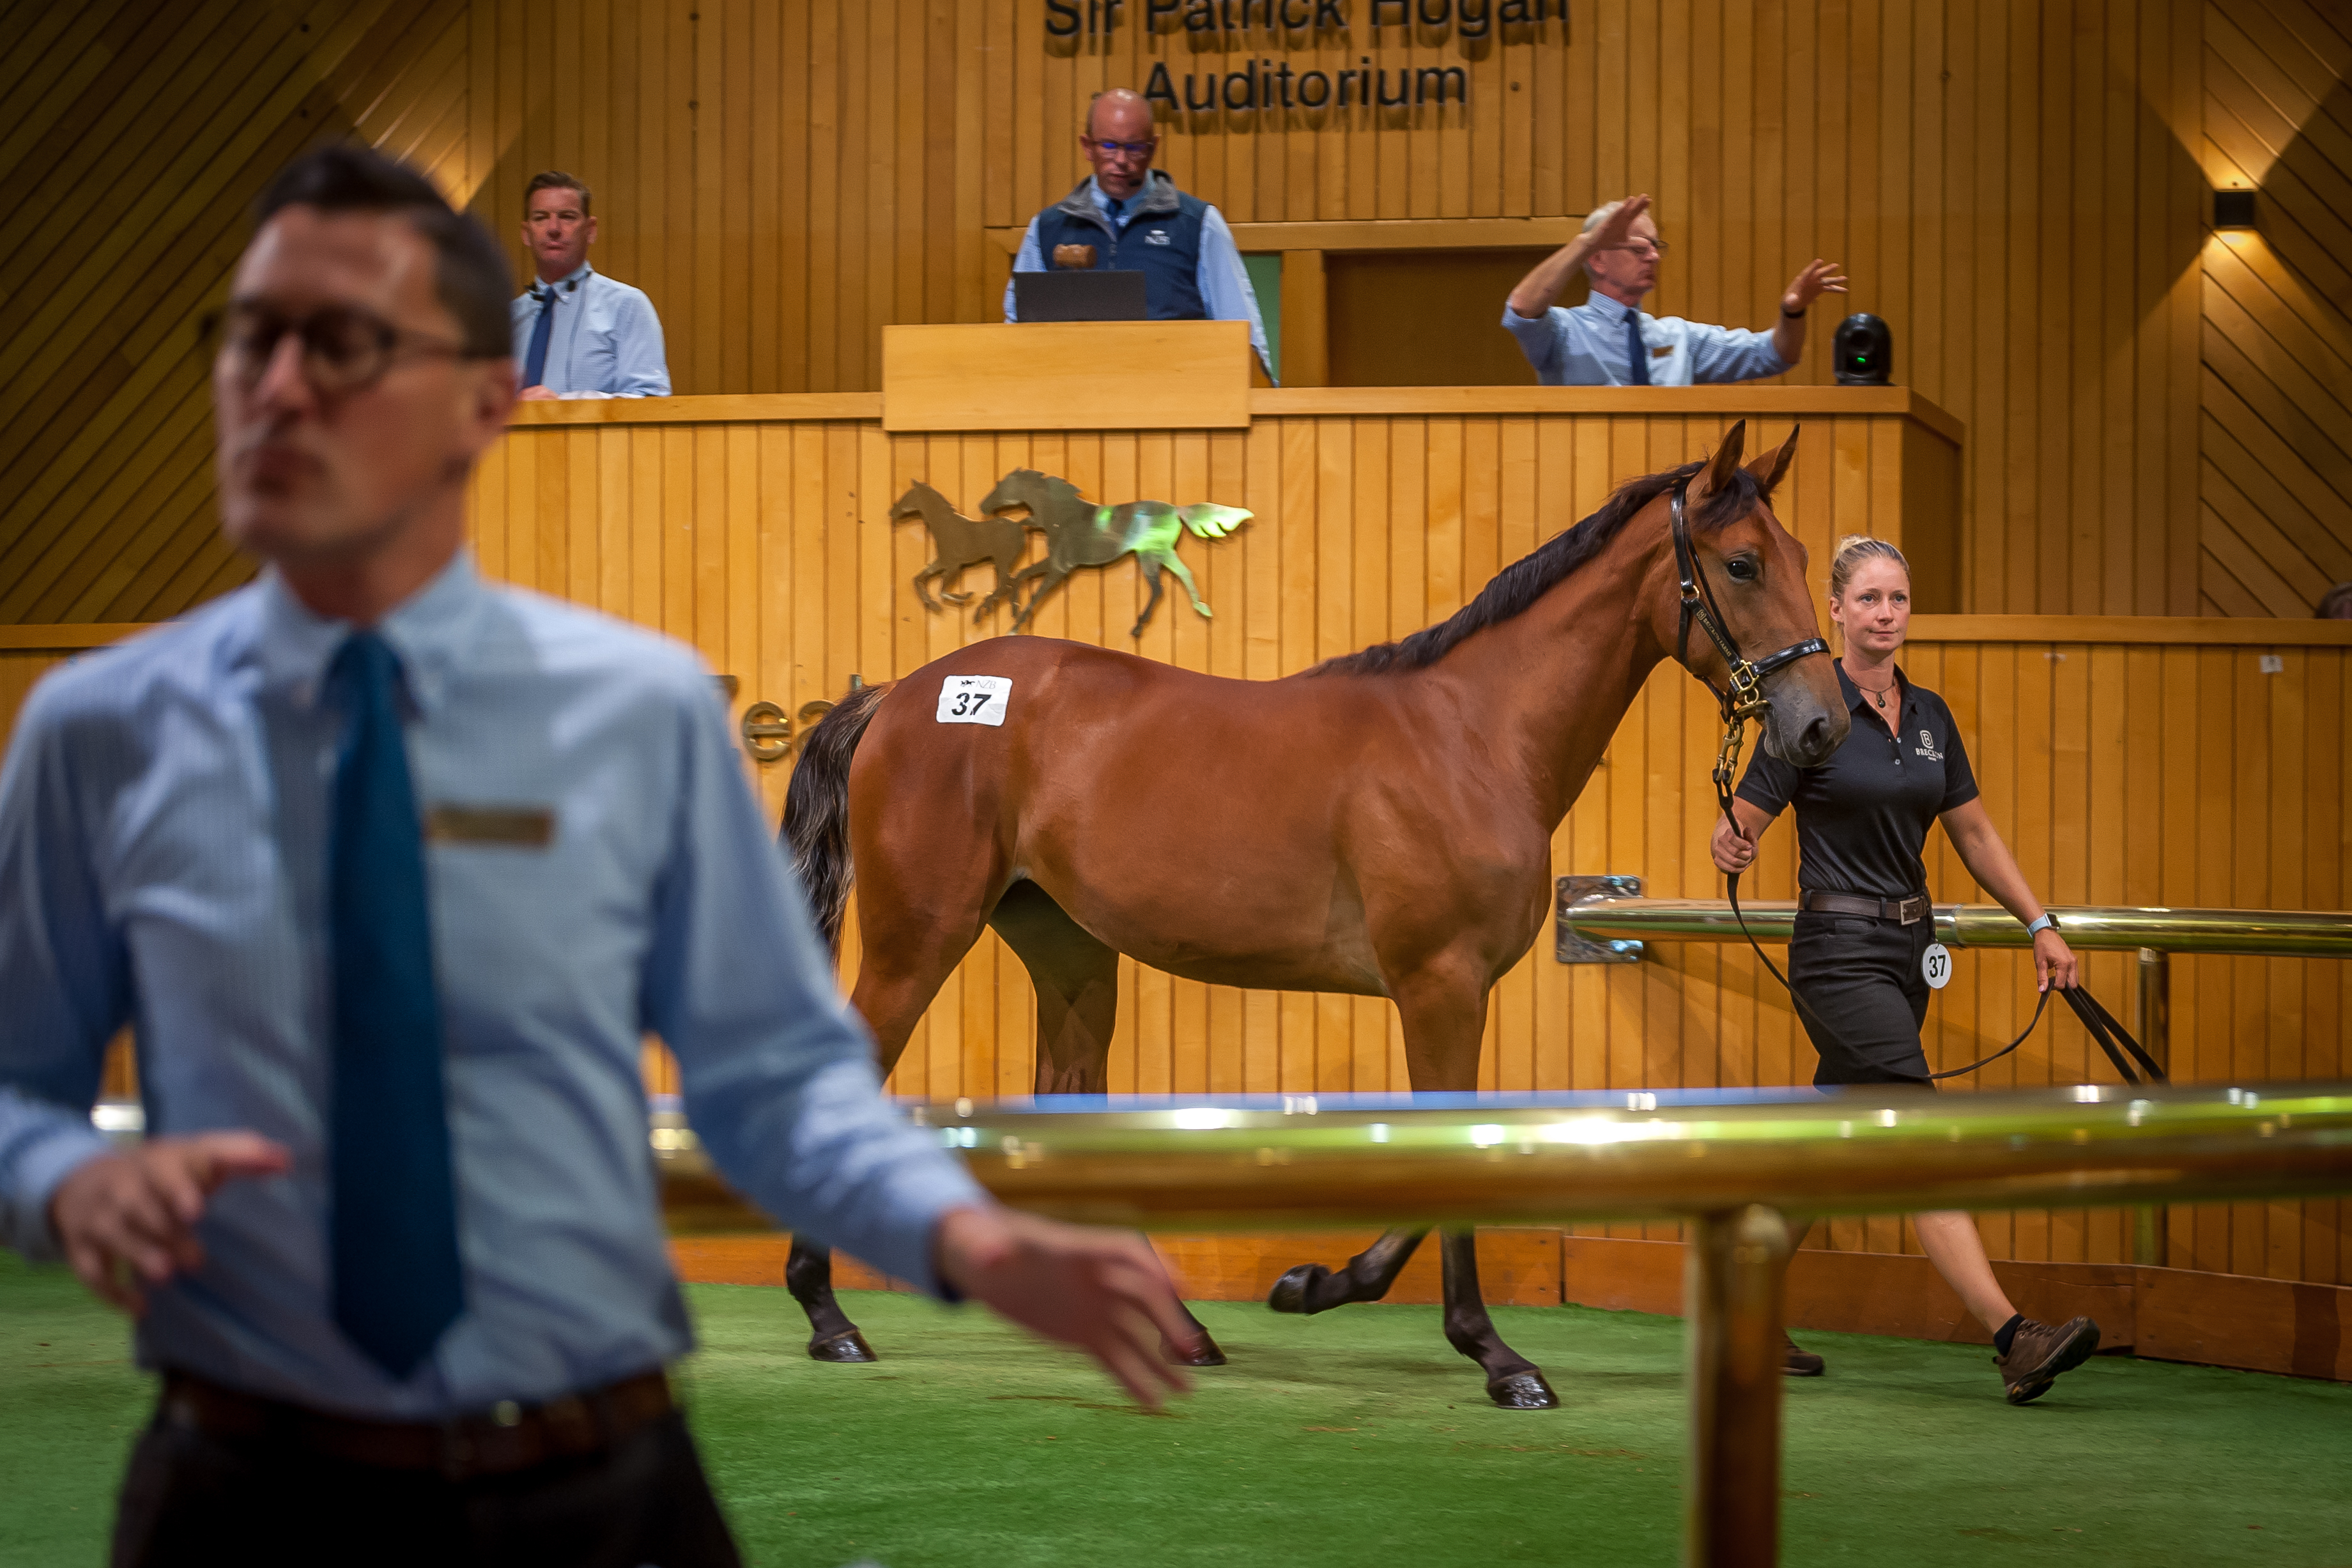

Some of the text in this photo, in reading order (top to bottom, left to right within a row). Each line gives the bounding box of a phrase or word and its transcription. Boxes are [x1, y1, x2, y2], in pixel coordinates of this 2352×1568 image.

[1046, 0, 1568, 36] Sir Patrick Hogan
[1146, 56, 1467, 110] Auditorium
[976, 680, 997, 689] NZB
[951, 692, 992, 716] 37
[1928, 954, 1946, 978] 37
